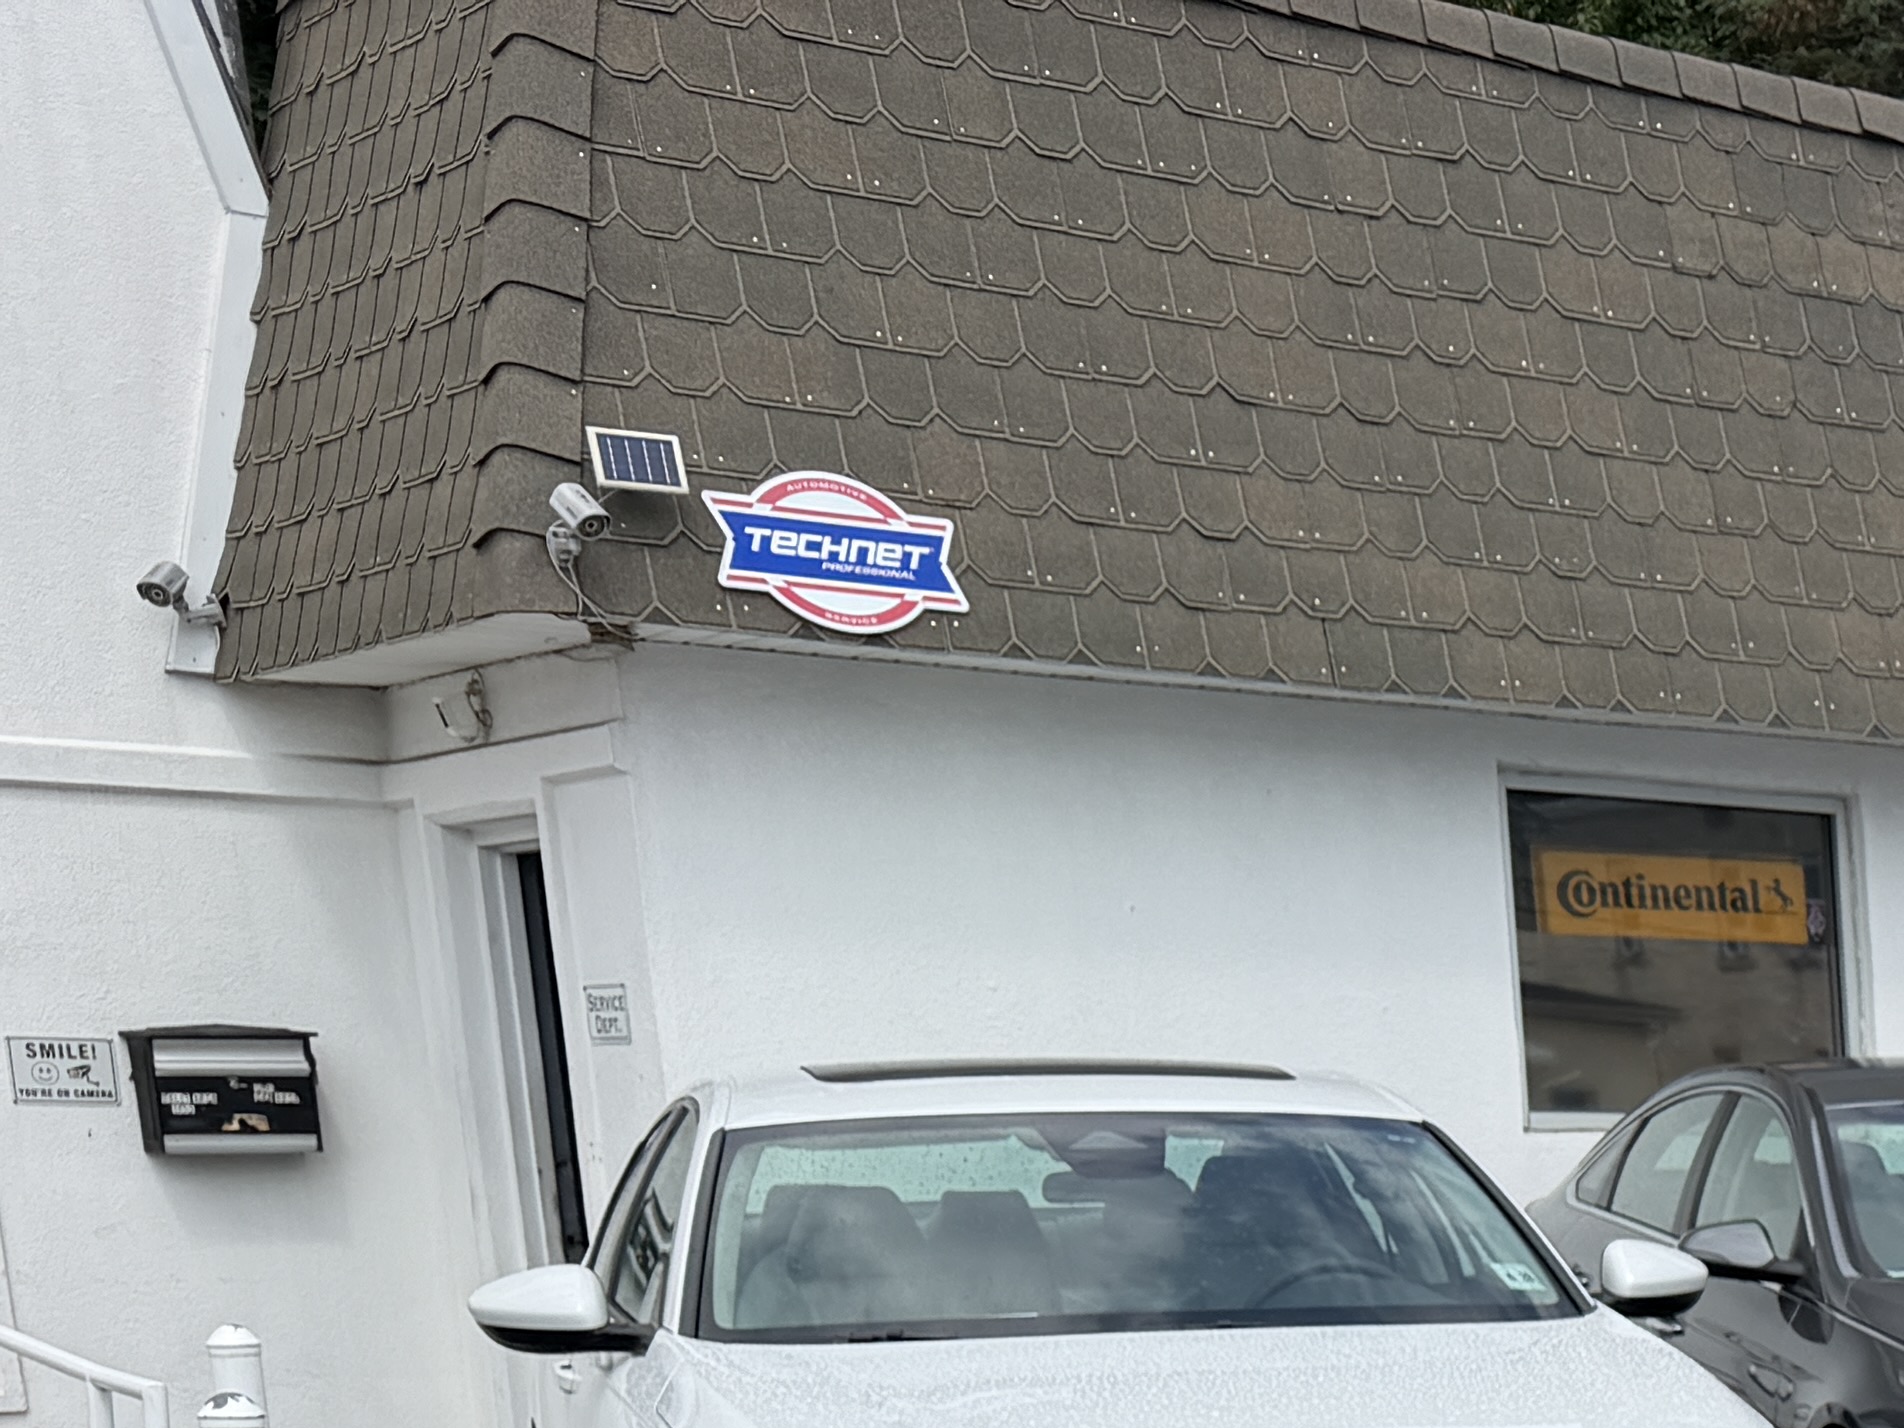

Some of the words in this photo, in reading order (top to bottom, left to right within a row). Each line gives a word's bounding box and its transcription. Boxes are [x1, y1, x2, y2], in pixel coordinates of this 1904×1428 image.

[821, 561, 917, 581] PROFESSIONAL
[1556, 869, 1763, 918] Continental
[587, 992, 625, 1013] SERVICE
[25, 1042, 97, 1060] SMILE!
